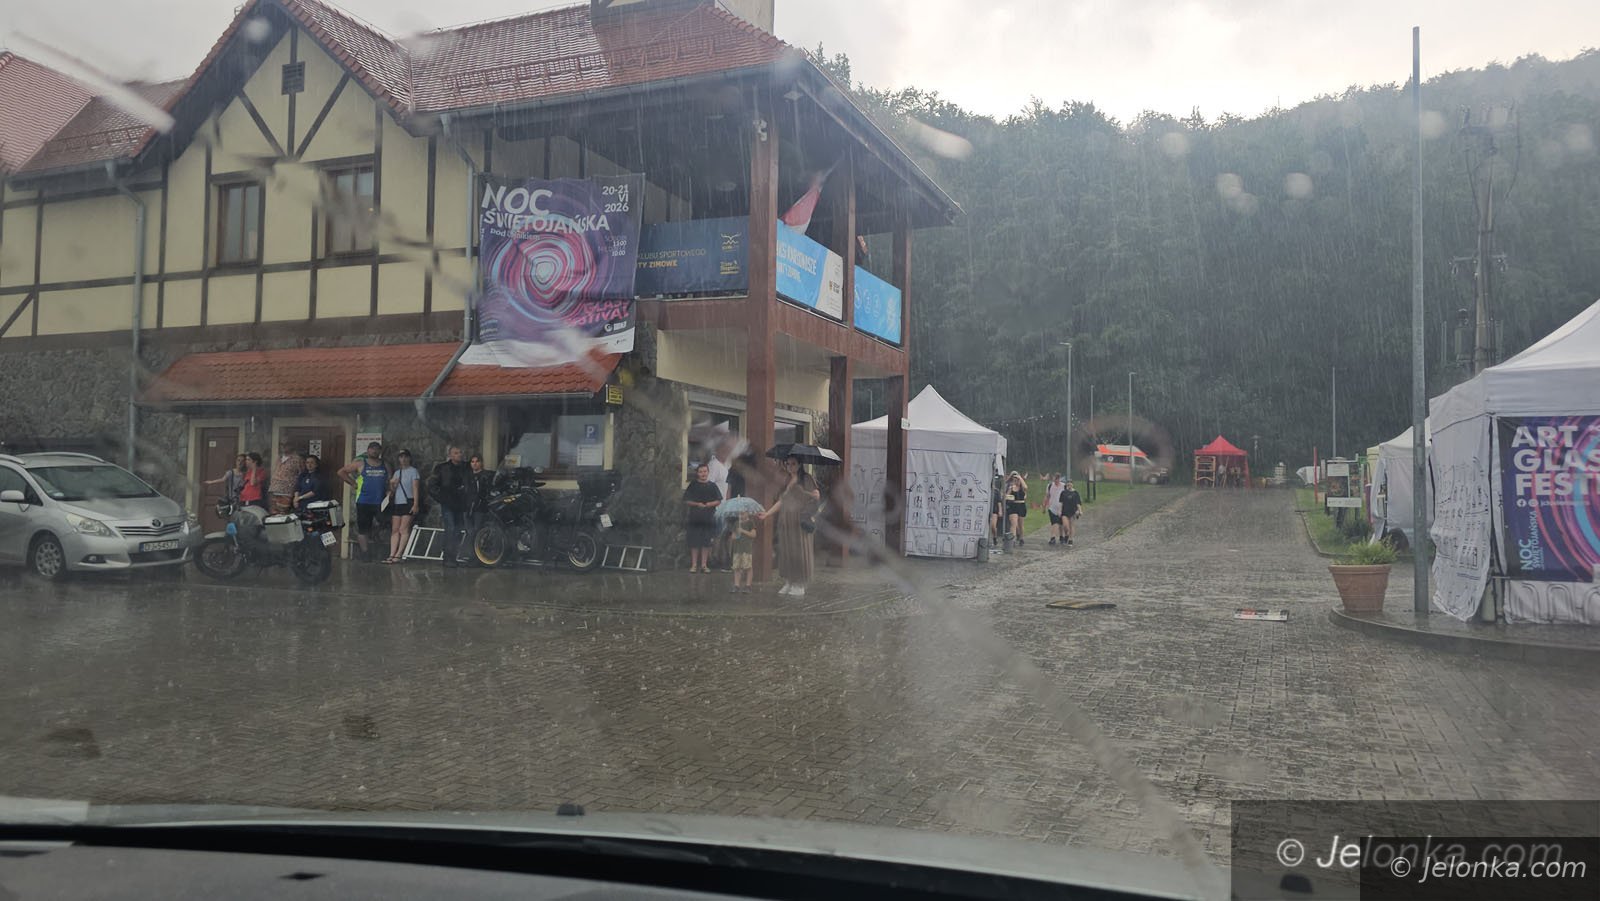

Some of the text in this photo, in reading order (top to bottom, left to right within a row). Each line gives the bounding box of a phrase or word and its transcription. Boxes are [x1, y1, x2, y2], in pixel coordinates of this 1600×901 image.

[481, 183, 553, 216] NOC
[602, 184, 629, 195] 20-21
[617, 193, 629, 203] VI
[604, 203, 630, 213] 2026
[1511, 425, 1579, 449] ART
[1515, 473, 1600, 496] FEST
[1518, 539, 1534, 571] NOC
